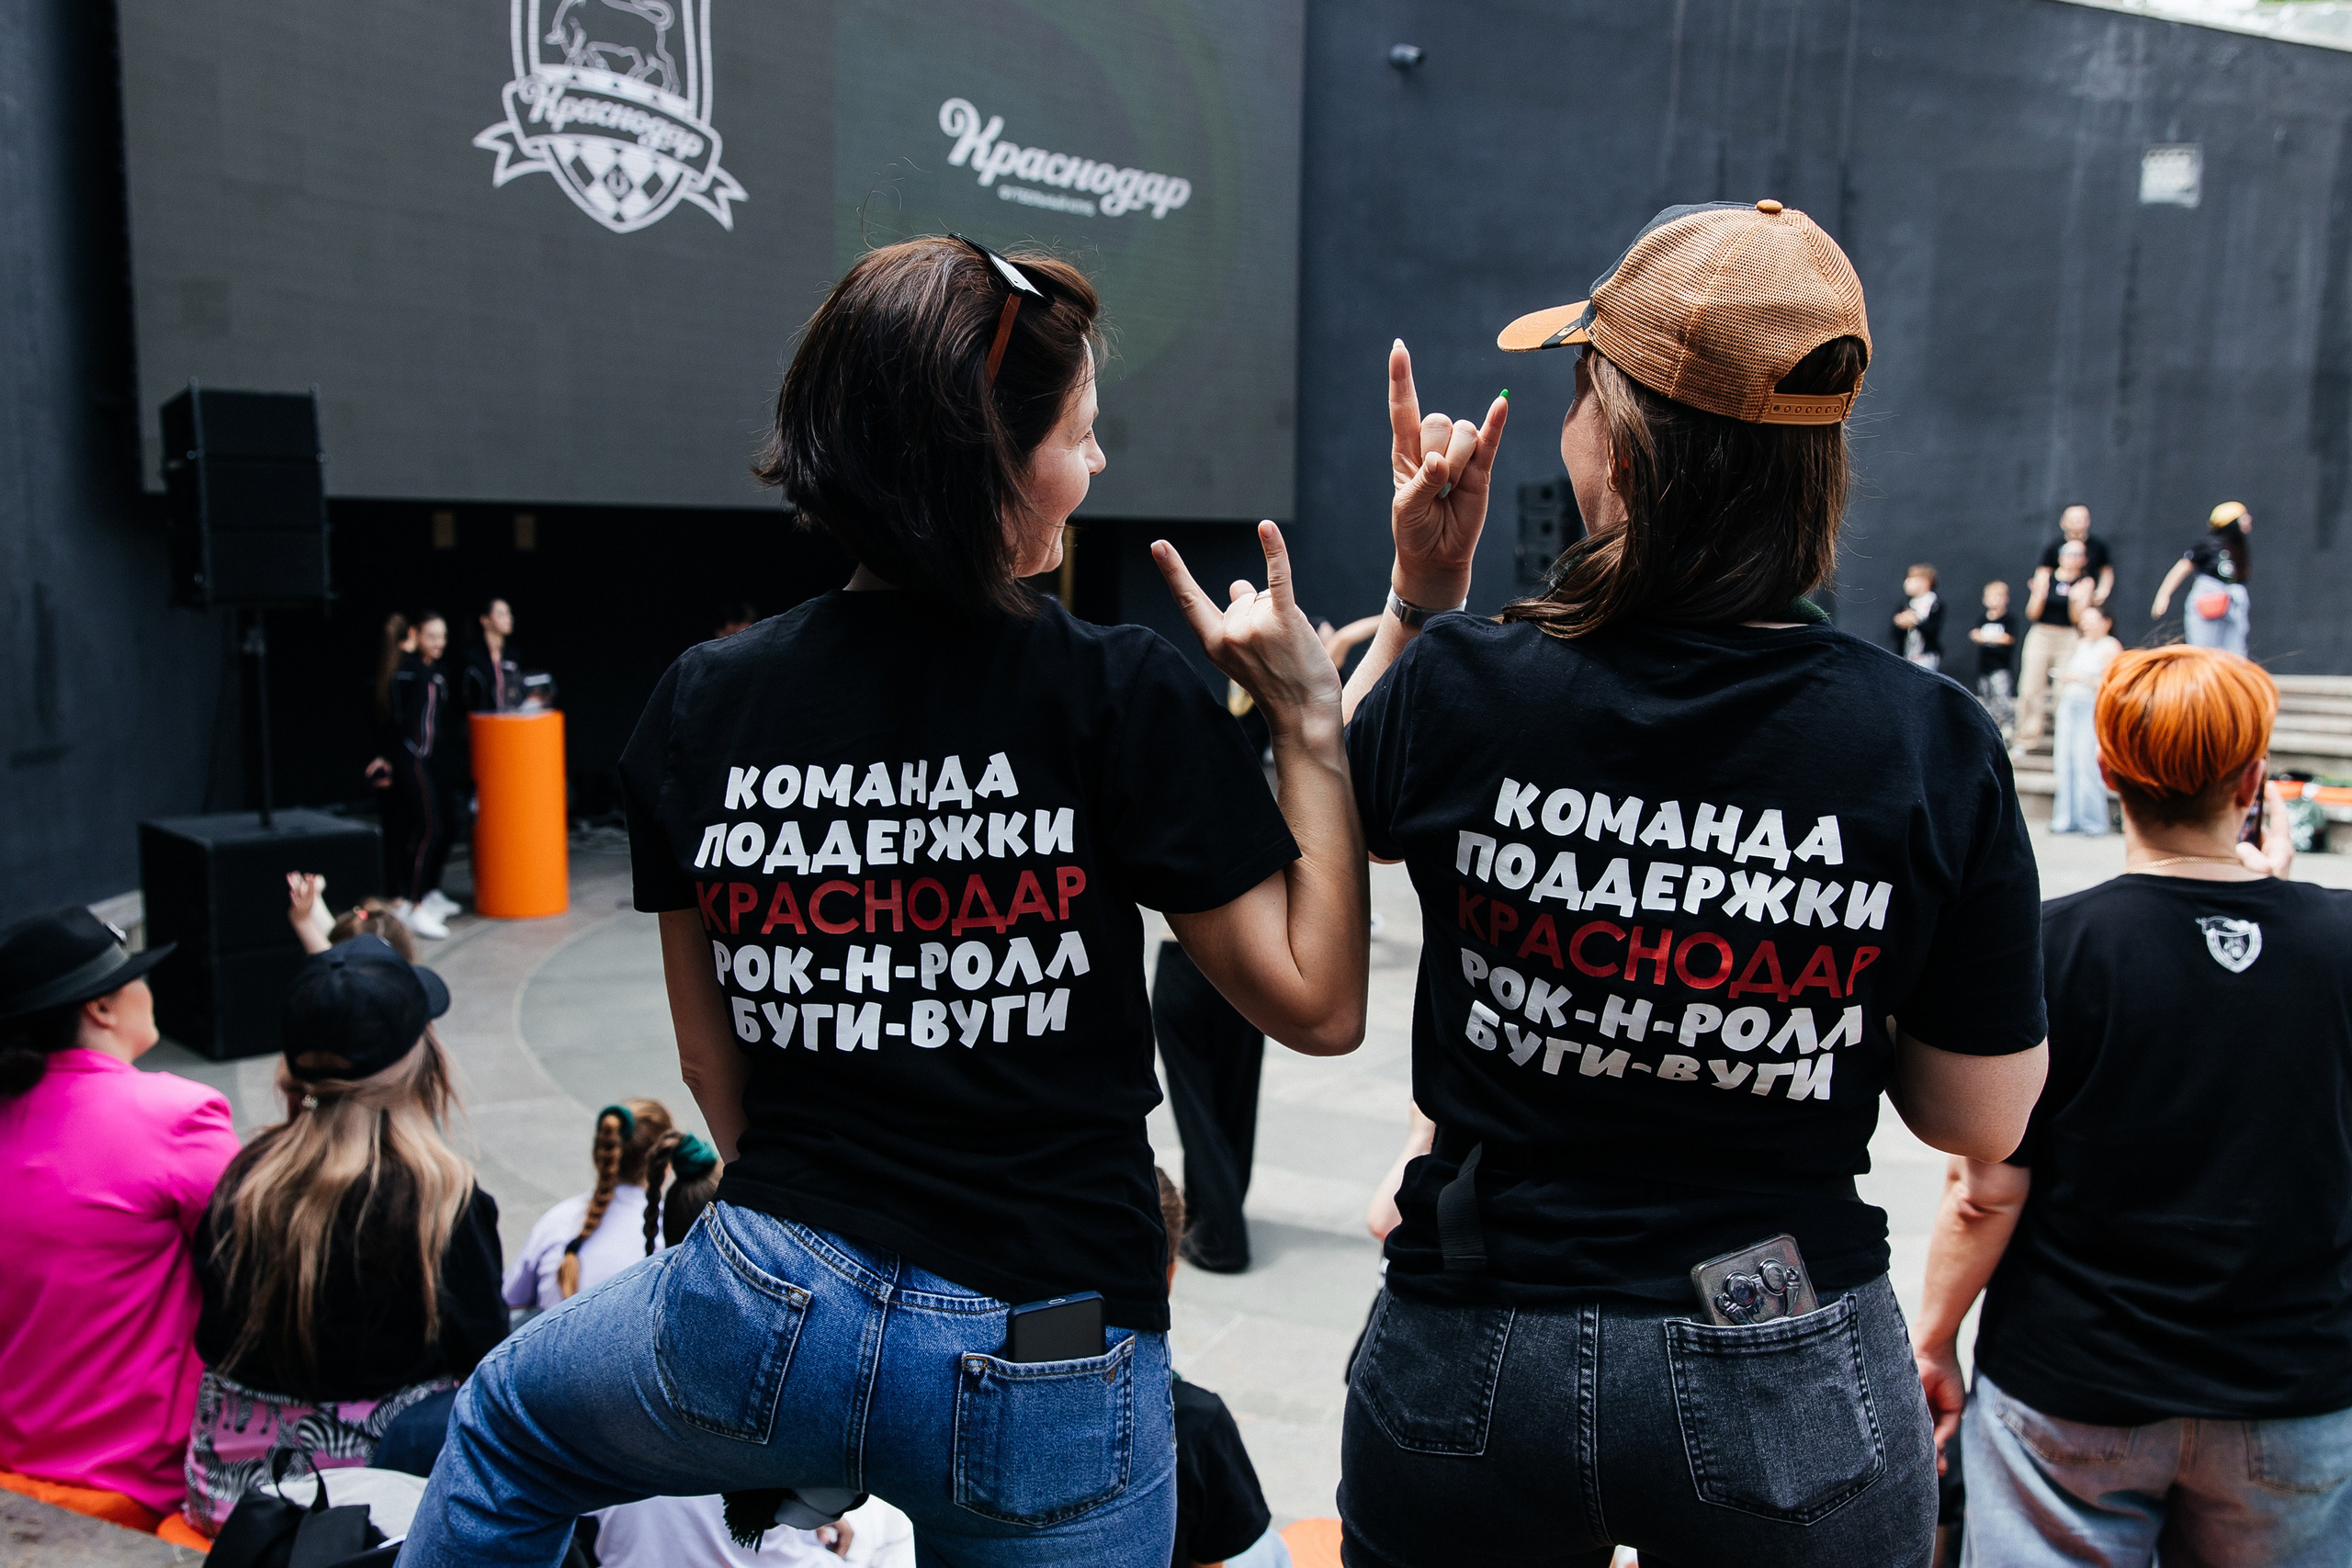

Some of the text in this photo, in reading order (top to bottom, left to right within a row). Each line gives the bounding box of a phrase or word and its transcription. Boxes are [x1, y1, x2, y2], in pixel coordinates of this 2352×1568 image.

[938, 96, 1192, 220] Краснодар
[724, 751, 1020, 810] КОМАНДА
[1494, 777, 1844, 871] КОМАНДА
[694, 807, 1075, 875] ПОДДЕРЖКИ
[1456, 829, 1893, 930] ПОДДЕРЖКИ
[695, 865, 1087, 937] КРАСНОДАР
[1457, 884, 1882, 1003] КРАСНОДАР
[713, 931, 1091, 995] РОК-Н-РОЛЛ
[1461, 947, 1862, 1055] РОК-Н-РОЛЛ
[731, 987, 1071, 1052] БУГИ-ВУГИ
[1464, 999, 1834, 1100] БУГИ-ВУГИ
